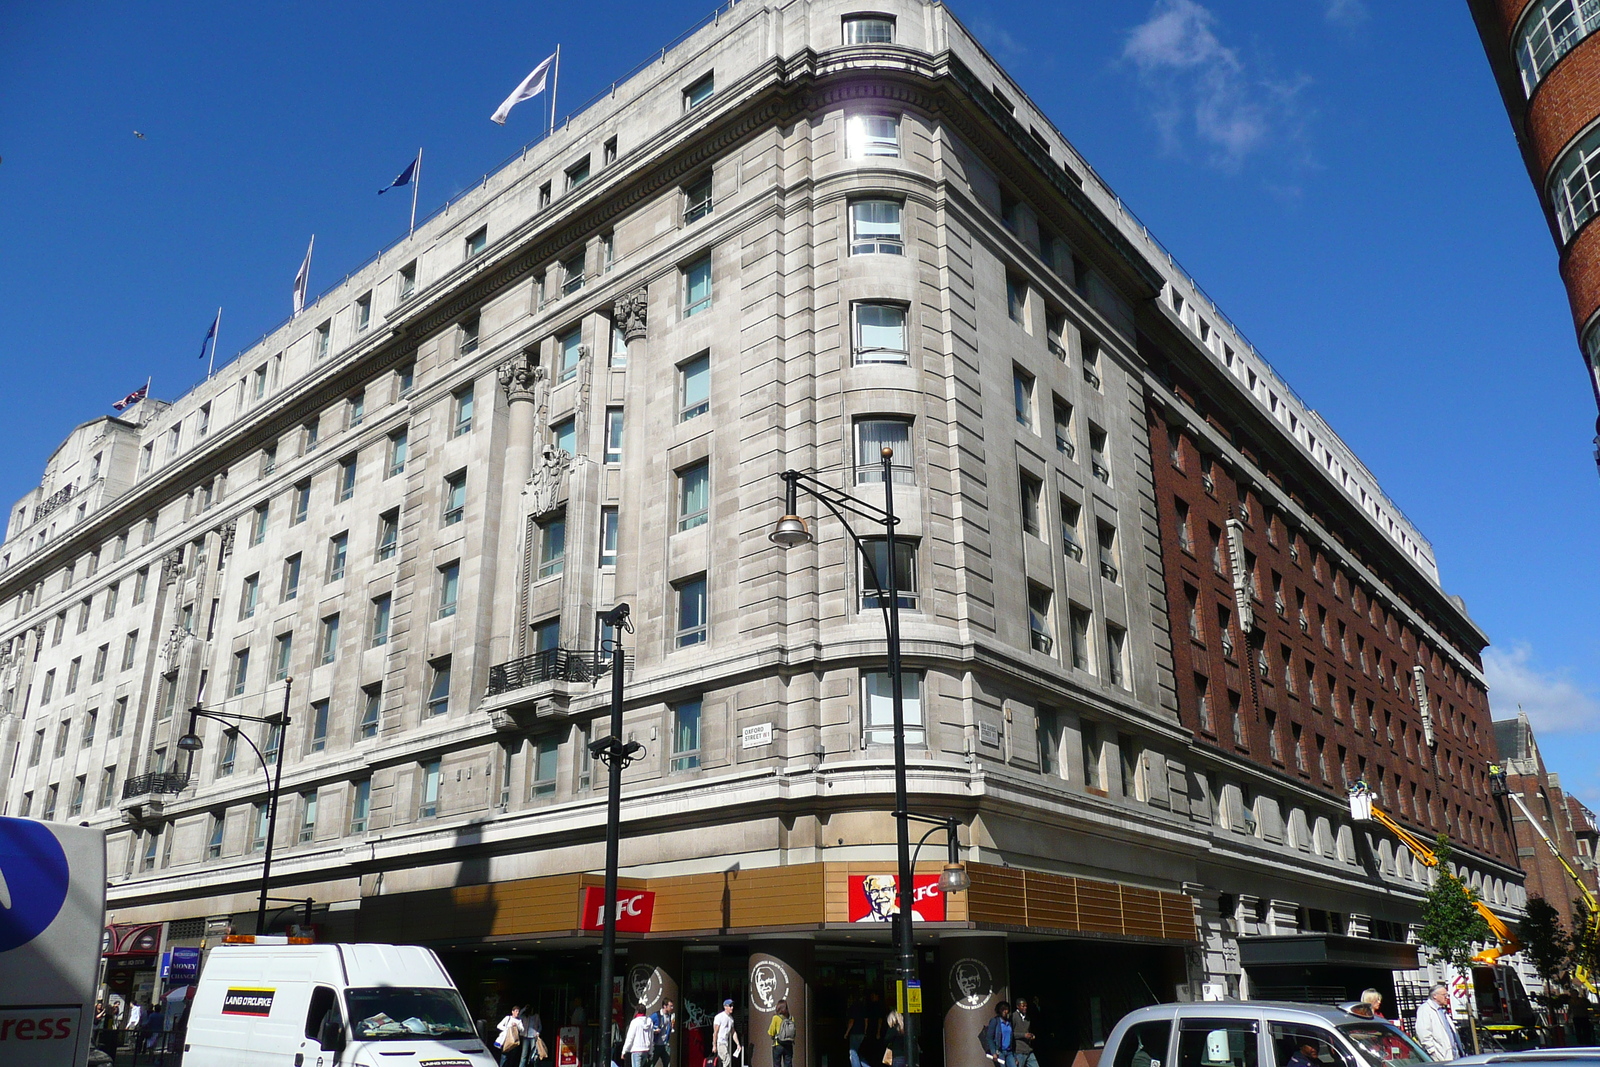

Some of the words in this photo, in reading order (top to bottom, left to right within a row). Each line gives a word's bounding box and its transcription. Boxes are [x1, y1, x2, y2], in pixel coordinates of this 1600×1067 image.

[745, 726, 764, 736] OXFORD
[745, 733, 761, 741] STREET
[225, 996, 243, 1005] LAING
[0, 1017, 71, 1041] ress
